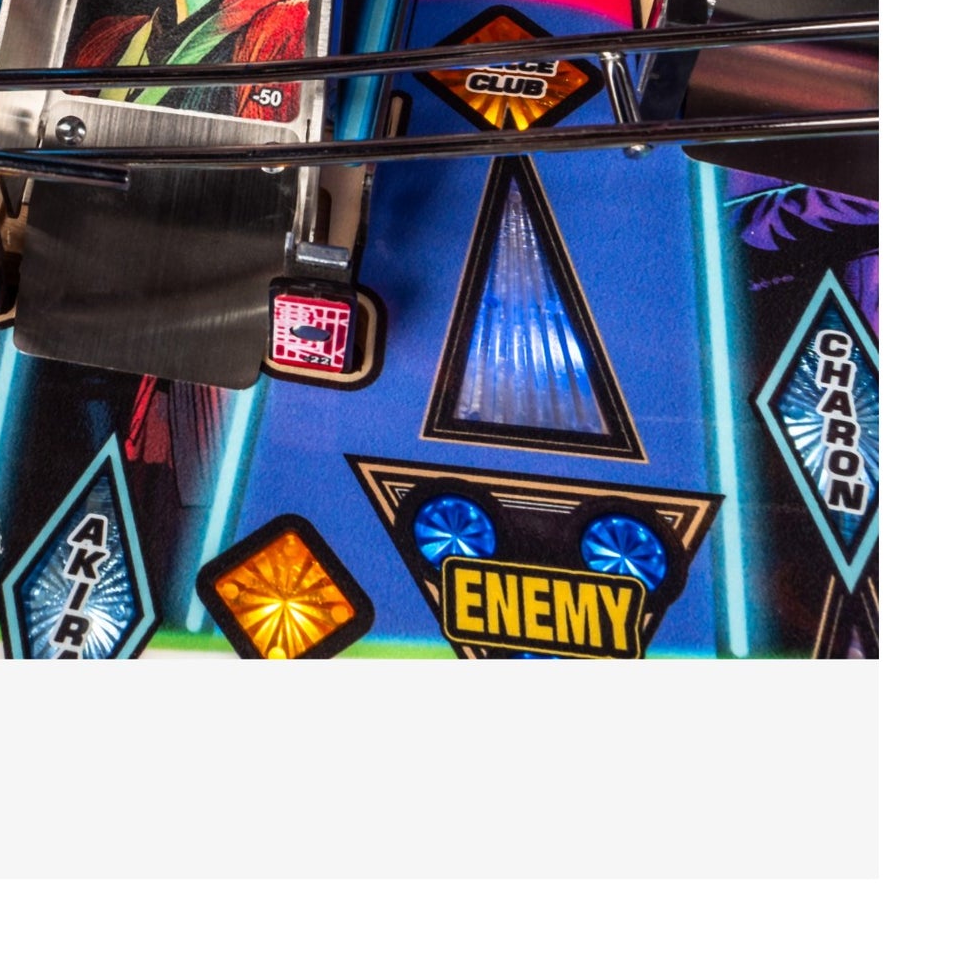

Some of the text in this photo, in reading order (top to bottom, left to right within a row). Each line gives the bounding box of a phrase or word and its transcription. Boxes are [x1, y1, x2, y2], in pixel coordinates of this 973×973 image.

[251, 87, 283, 107] -50
[467, 73, 547, 98] CLUB
[819, 331, 866, 513] CHARON
[454, 568, 633, 651] ENEMY
